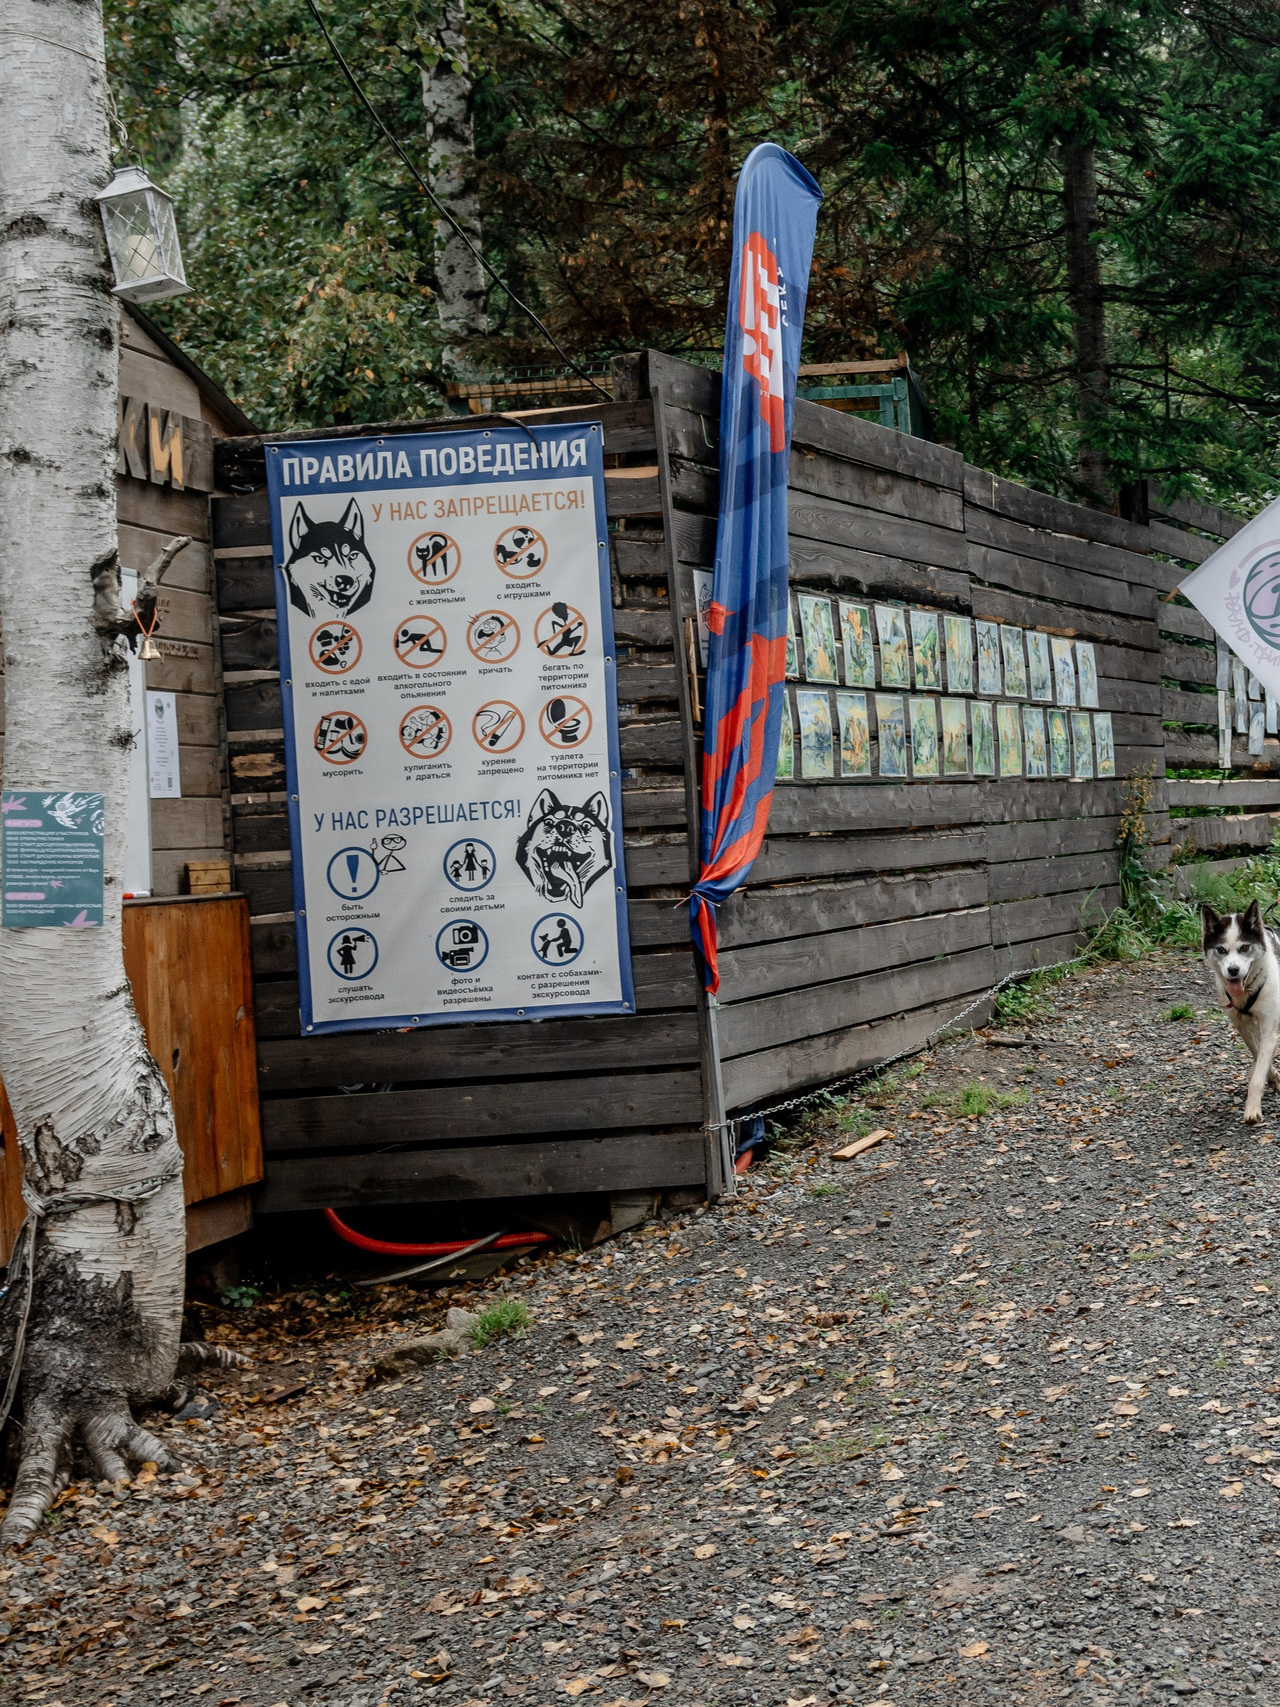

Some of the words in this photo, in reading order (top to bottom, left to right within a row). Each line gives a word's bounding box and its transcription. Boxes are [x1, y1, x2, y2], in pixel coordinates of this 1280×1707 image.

[282, 450, 413, 486] ПРАВИЛА
[420, 437, 588, 477] ПОВЕДЕНИЯ
[371, 502, 383, 523] У
[390, 501, 428, 522] НАС
[433, 489, 587, 518] ЗАПРЕЩАЕТСЯ!
[420, 586, 455, 596] входить
[505, 581, 541, 591] входить
[503, 590, 551, 600] игрушками
[415, 596, 466, 606] животными
[478, 667, 513, 676] кричать
[542, 663, 571, 672] бегать
[377, 674, 413, 683] входить
[422, 669, 467, 679] состоянии
[538, 672, 589, 683] территории
[305, 680, 340, 690] входить
[349, 677, 371, 687] едой
[393, 680, 452, 691] алкогольного
[541, 682, 588, 692] питомника
[312, 690, 318, 698] и
[319, 687, 365, 697] напитками
[400, 690, 447, 700] опьянения
[481, 757, 517, 768] курение
[550, 753, 584, 761] туалета
[403, 762, 452, 773] хулиганить
[548, 761, 599, 772] территории
[322, 768, 364, 779] мусорить
[415, 771, 451, 782] драться
[477, 767, 525, 778] запрещено
[537, 772, 583, 782] питомника
[585, 771, 599, 779] нет
[313, 812, 325, 833] У
[331, 809, 369, 832] НАС
[375, 798, 522, 829] РАЗРЕШАЕТСЯ!
[449, 894, 484, 904] следить
[485, 893, 496, 901] за
[341, 902, 364, 912] быть
[440, 905, 472, 914] своими
[473, 902, 506, 912] детьми
[326, 911, 381, 923] осторожным
[517, 972, 550, 981] контакт
[551, 971, 557, 979] с
[558, 968, 603, 978] собаками-
[451, 976, 474, 986] фото
[537, 978, 590, 990] разрешения
[338, 984, 374, 994] слушать
[436, 984, 494, 996] видеосъёмка
[531, 988, 591, 1000] экскурсовода
[328, 992, 385, 1004] экскурсовода
[442, 995, 492, 1006] разрешены
